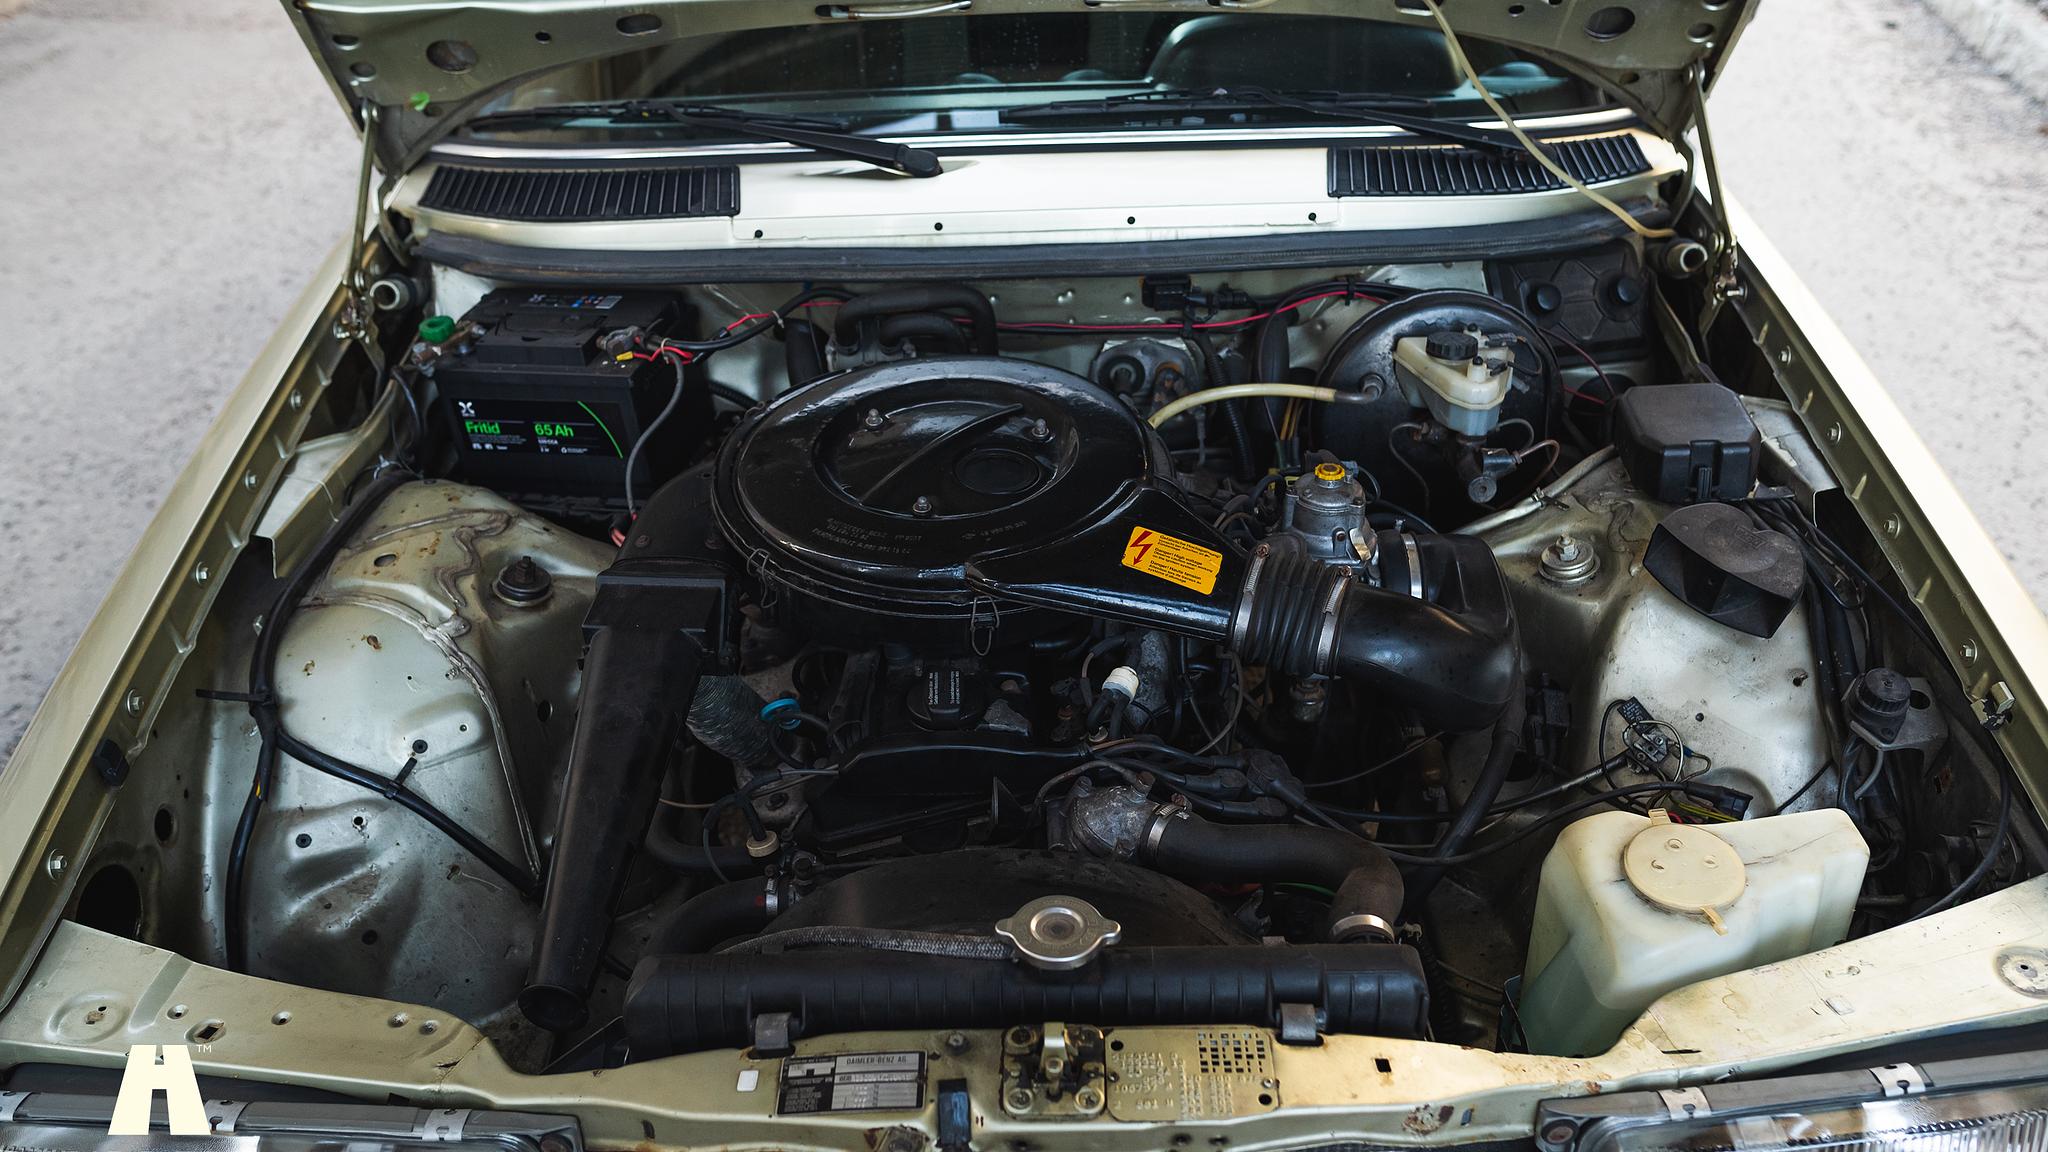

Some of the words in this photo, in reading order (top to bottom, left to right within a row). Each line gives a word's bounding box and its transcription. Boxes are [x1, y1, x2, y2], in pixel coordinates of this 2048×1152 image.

[465, 421, 501, 434] Fritid
[535, 423, 553, 436] 65
[555, 425, 574, 437] Ah
[846, 1056, 895, 1065] DAIMLER-BENZ
